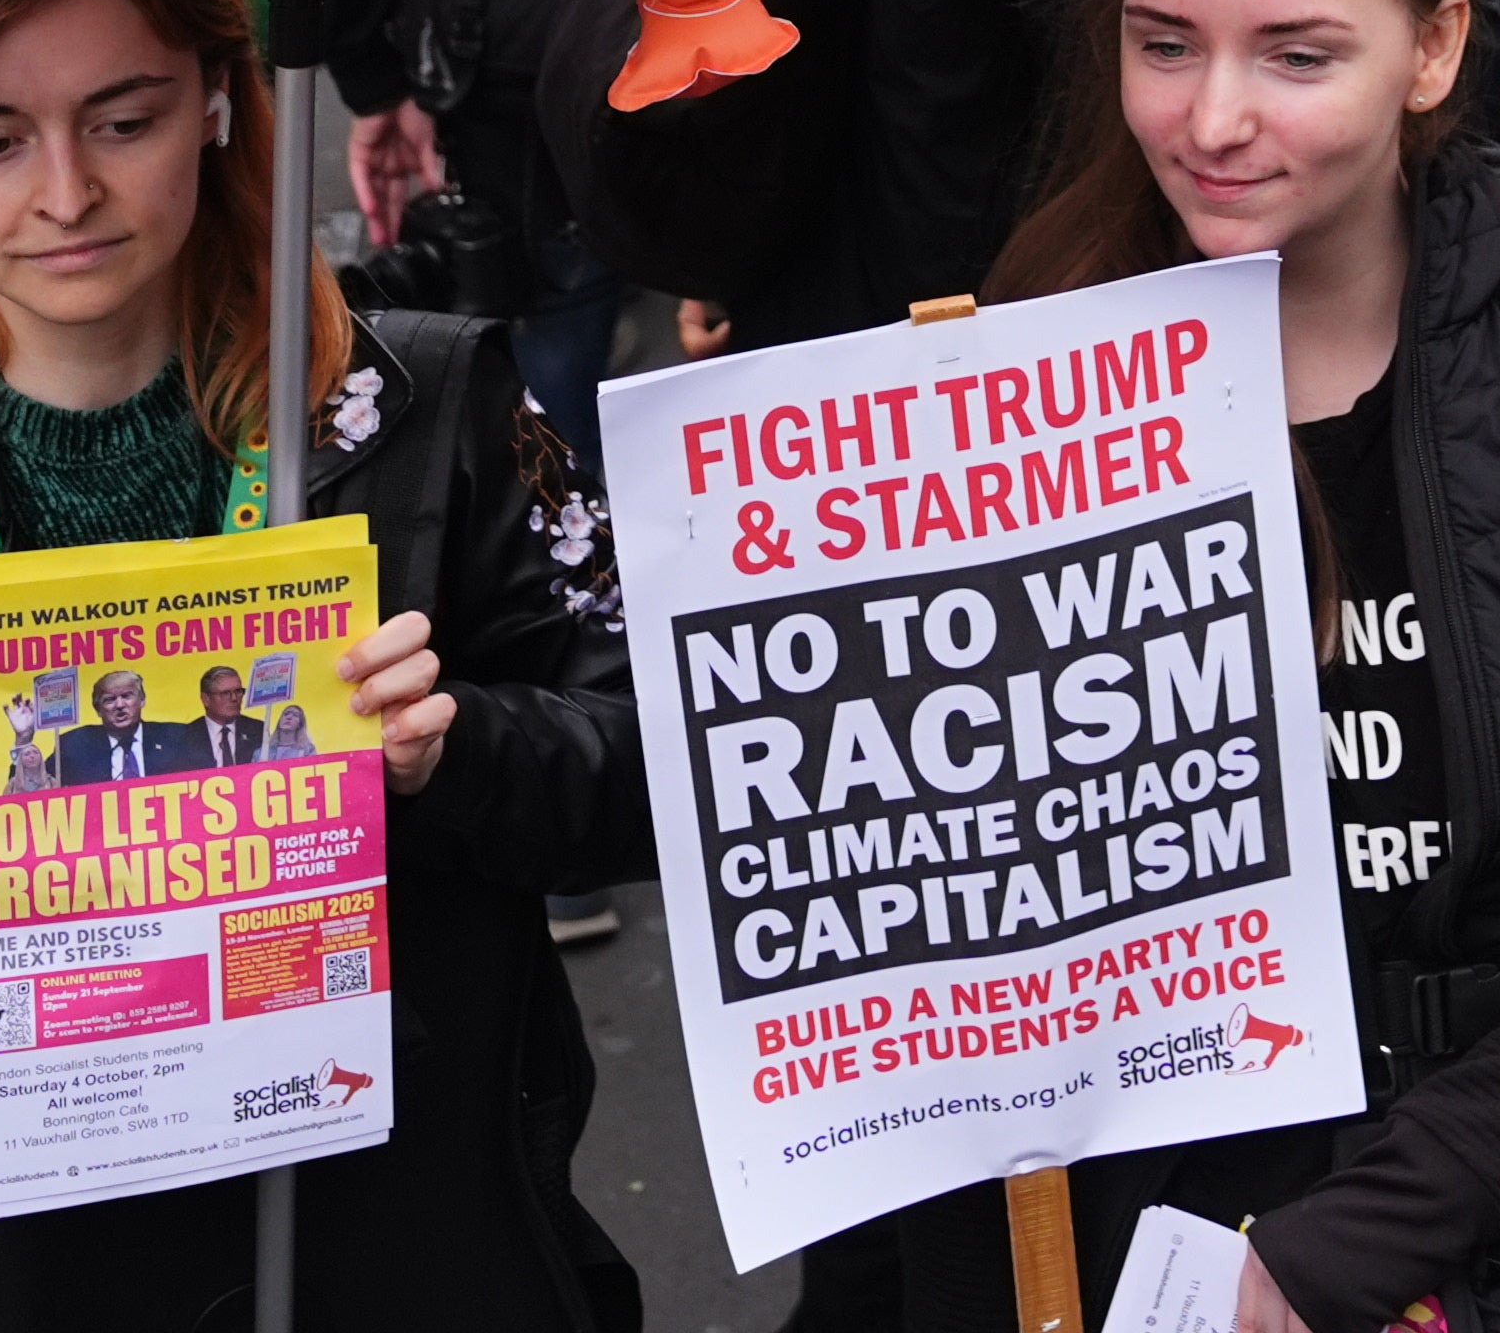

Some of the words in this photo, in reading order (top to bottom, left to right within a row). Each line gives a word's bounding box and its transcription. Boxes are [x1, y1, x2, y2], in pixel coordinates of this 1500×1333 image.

[682, 384, 919, 496] FIGHT
[934, 318, 1209, 452] TRUMP
[731, 499, 796, 576] &
[816, 414, 1192, 562] STARMER
[31, 598, 150, 626] WALKOUT
[155, 587, 260, 613] AGAINST
[266, 575, 350, 600] TRUMP
[685, 611, 840, 713] NO
[863, 587, 998, 679] TO
[1021, 519, 1255, 651] WAR
[155, 613, 238, 657] CAN
[243, 600, 354, 648] FIGHT
[1341, 591, 1427, 667] NG
[705, 611, 1259, 834] RACISM
[1319, 709, 1403, 781] ND
[101, 775, 238, 849] LET'S
[250, 761, 349, 829] GET
[719, 798, 1021, 899] CLIMATE
[1034, 735, 1261, 843] CHAOS
[275, 833, 317, 852] FIGHT
[320, 829, 349, 846] FOR
[351, 825, 366, 839] A
[275, 840, 360, 867] SOCIALIST
[275, 859, 337, 882] FUTURE
[733, 794, 1267, 980] CAPITALISM
[224, 899, 325, 935] SOCIALISM
[327, 890, 375, 918] 2025
[1, 950, 57, 971] NEXT
[64, 943, 132, 963] STEPS:
[25, 930, 71, 950] AND
[77, 921, 164, 945] DISCUSS
[40, 973, 86, 988] ONLINE
[89, 967, 143, 983] MEETING
[42, 989, 79, 1002] Sunday
[80, 986, 91, 998] 21
[92, 983, 145, 998] September
[755, 995, 894, 1058] BUILD
[907, 987, 937, 1022] A
[950, 968, 1056, 1017] NEW
[1065, 921, 1206, 993] PARTY
[1213, 908, 1270, 951] TO
[751, 1043, 861, 1105] GIVE
[870, 998, 1100, 1074] STUDENTS
[1110, 985, 1141, 1023] A
[1150, 948, 1287, 1010] VOICE
[1116, 1022, 1227, 1069] socialist
[35, 1059, 90, 1076] Socialist
[92, 1051, 150, 1068] Students
[152, 1041, 204, 1060] meeting
[71, 1076, 81, 1088] 4
[84, 1067, 149, 1086] October,
[152, 1060, 186, 1078] 2pm
[1118, 1046, 1236, 1090] students
[46, 1096, 68, 1111] All
[71, 1085, 144, 1107] welcome!
[233, 1072, 317, 1107] socialist
[233, 1091, 321, 1123] students
[3, 1139, 18, 1151] 11
[21, 1131, 78, 1149] Vauxhall
[80, 1124, 124, 1140] Grove,
[126, 1118, 160, 1133] SW8
[163, 1111, 190, 1126] 1TD
[42, 1108, 116, 1129] Bonnington
[118, 1103, 150, 1118] Cafe
[782, 1069, 1096, 1165] socialiststudents.org.uk
